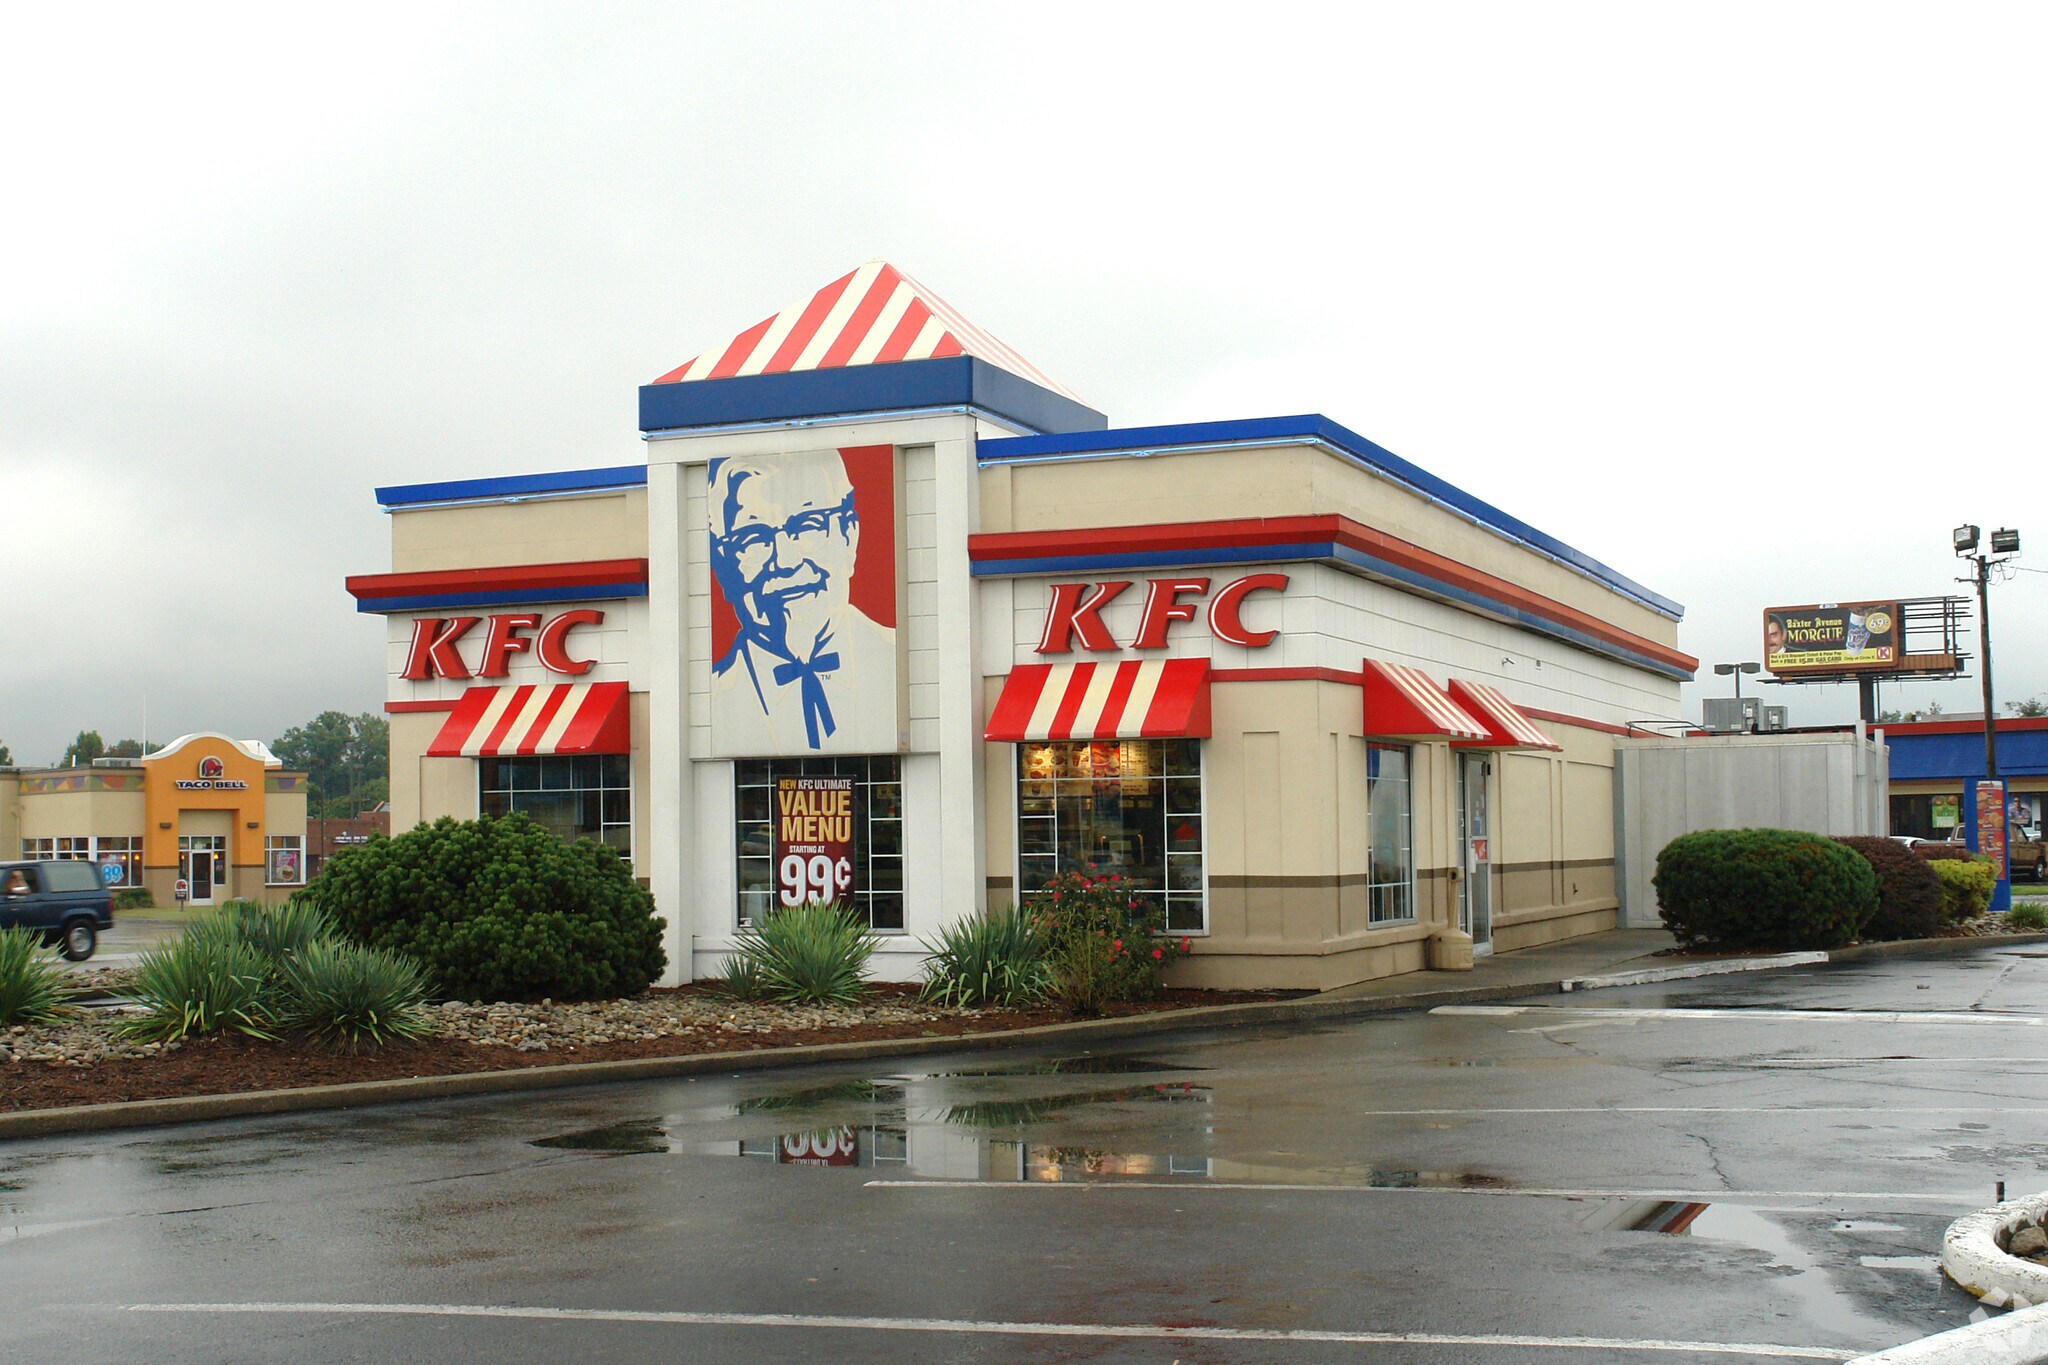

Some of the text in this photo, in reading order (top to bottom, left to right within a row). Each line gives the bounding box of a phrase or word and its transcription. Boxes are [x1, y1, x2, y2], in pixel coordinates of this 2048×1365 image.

[1033, 573, 1290, 654] KFC
[1786, 617, 1842, 628] Baxter Avenue
[1788, 627, 1844, 644] MORGUE
[399, 609, 605, 680] KFC
[176, 780, 248, 790] TACO BELL
[780, 779, 851, 790] NEW KFC ULTIMATE
[779, 790, 852, 816] VALUE
[782, 816, 851, 843] MENU
[789, 845, 826, 854] STARTING AT
